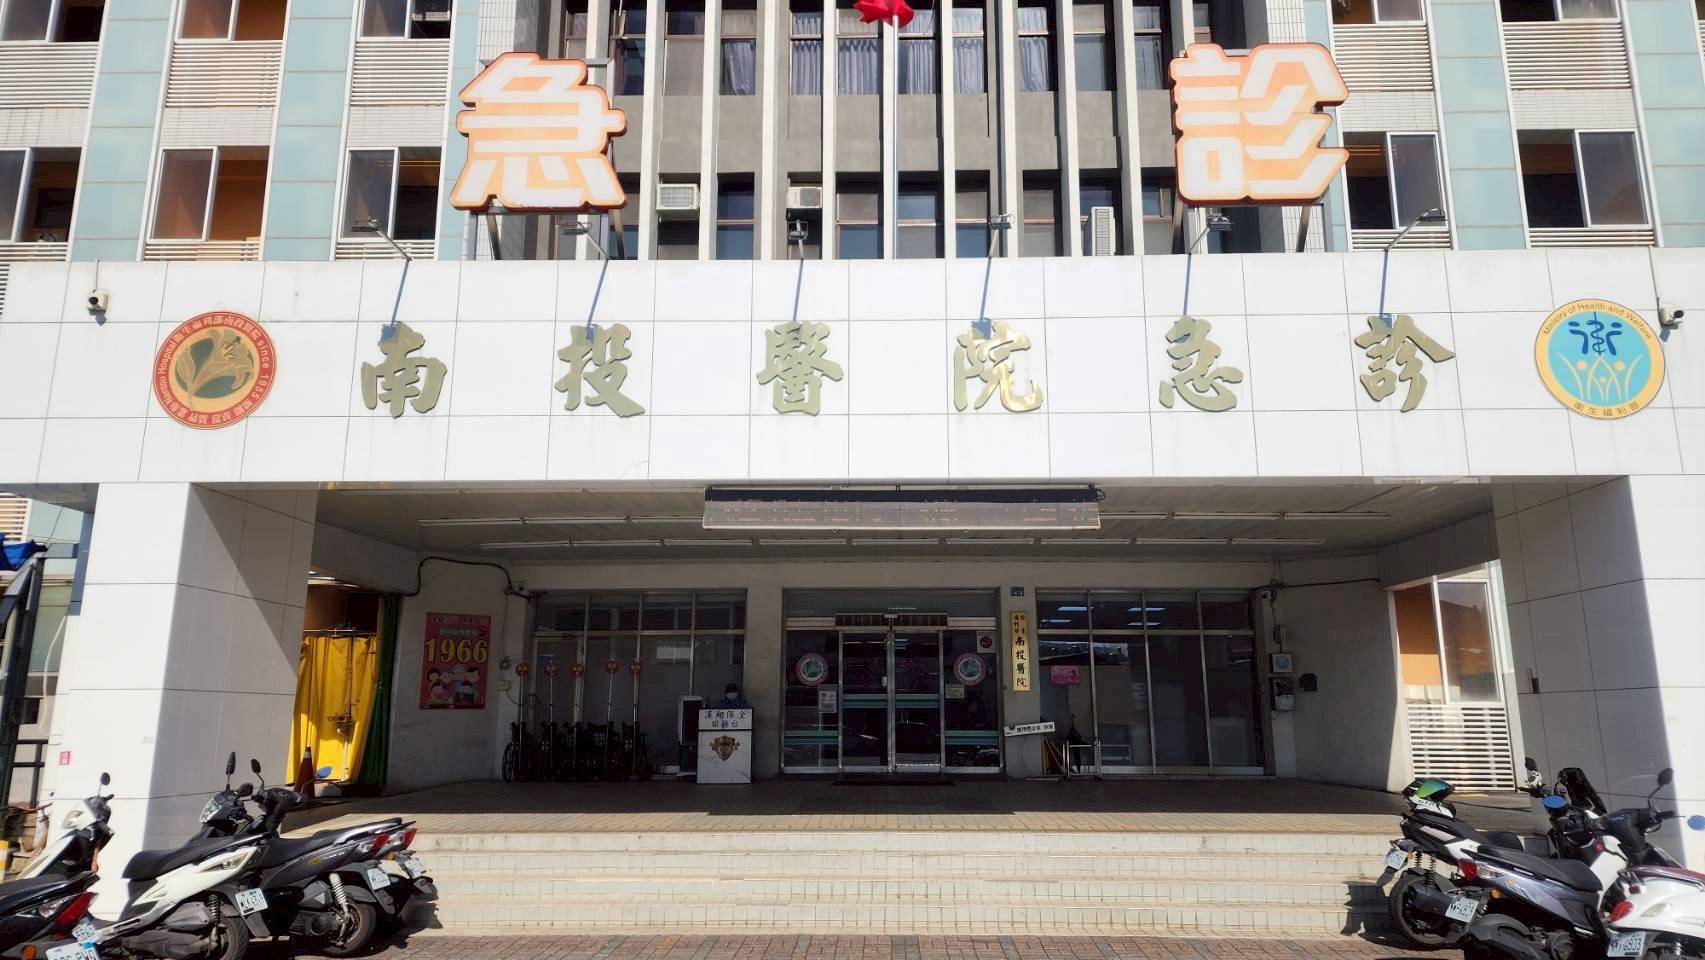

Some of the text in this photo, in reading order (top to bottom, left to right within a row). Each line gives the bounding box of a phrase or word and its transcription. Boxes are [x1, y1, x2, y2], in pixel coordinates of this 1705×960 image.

[449, 52, 627, 211] 急
[1169, 43, 1349, 206] 診
[1543, 311, 1567, 336] Ministry
[1568, 305, 1576, 314] of
[1607, 305, 1624, 316] and
[1626, 311, 1652, 339] Welfare
[158, 340, 177, 375] Hospital
[257, 340, 270, 369] since
[361, 315, 1455, 419] 南投醫院急診
[425, 638, 489, 664] 1966
[1014, 636, 1028, 688] 南投醫院
